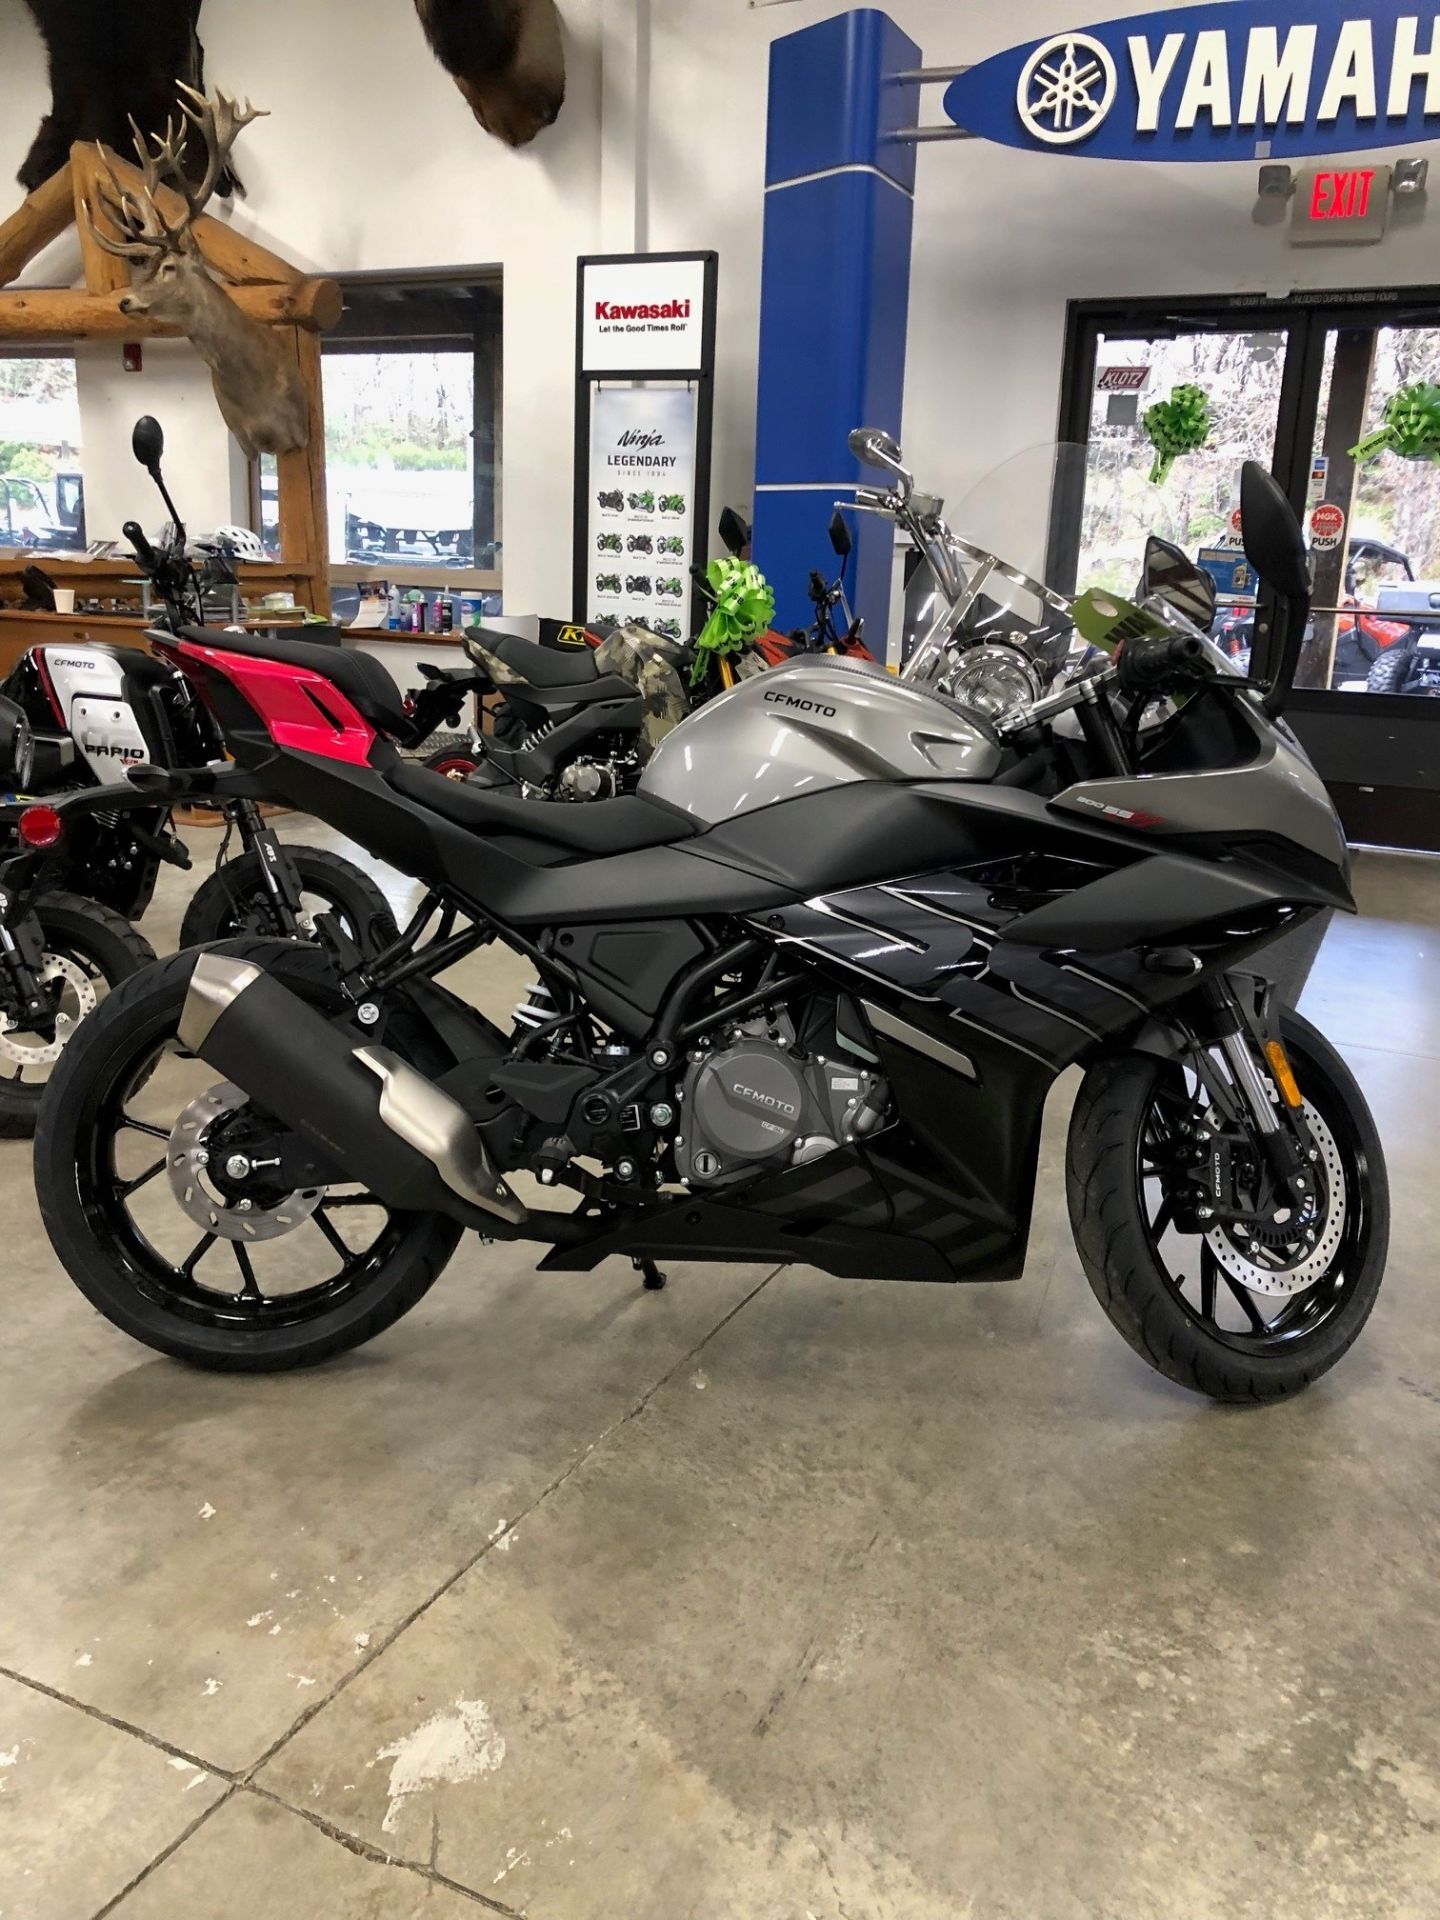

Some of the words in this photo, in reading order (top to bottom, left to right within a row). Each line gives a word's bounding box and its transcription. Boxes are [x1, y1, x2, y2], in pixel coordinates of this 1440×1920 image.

[1309, 171, 1376, 220] EXIT
[595, 299, 690, 320] Kawasaki
[599, 325, 611, 333] Let
[612, 325, 624, 333] the
[625, 324, 645, 333] Good
[647, 324, 669, 332] Times
[670, 323, 686, 331] Roll
[1104, 372, 1143, 386] KLOTZ
[617, 428, 665, 452] Ninja
[607, 455, 677, 467] LEGENDARY
[1316, 512, 1338, 521] NGK
[1229, 537, 1245, 546] PU
[1312, 537, 1337, 546] PUSH
[54, 658, 95, 670] CFMOTO
[763, 691, 837, 717] CFMOTO
[84, 744, 144, 759] PAPIO
[733, 1083, 795, 1114] CFMOTO
